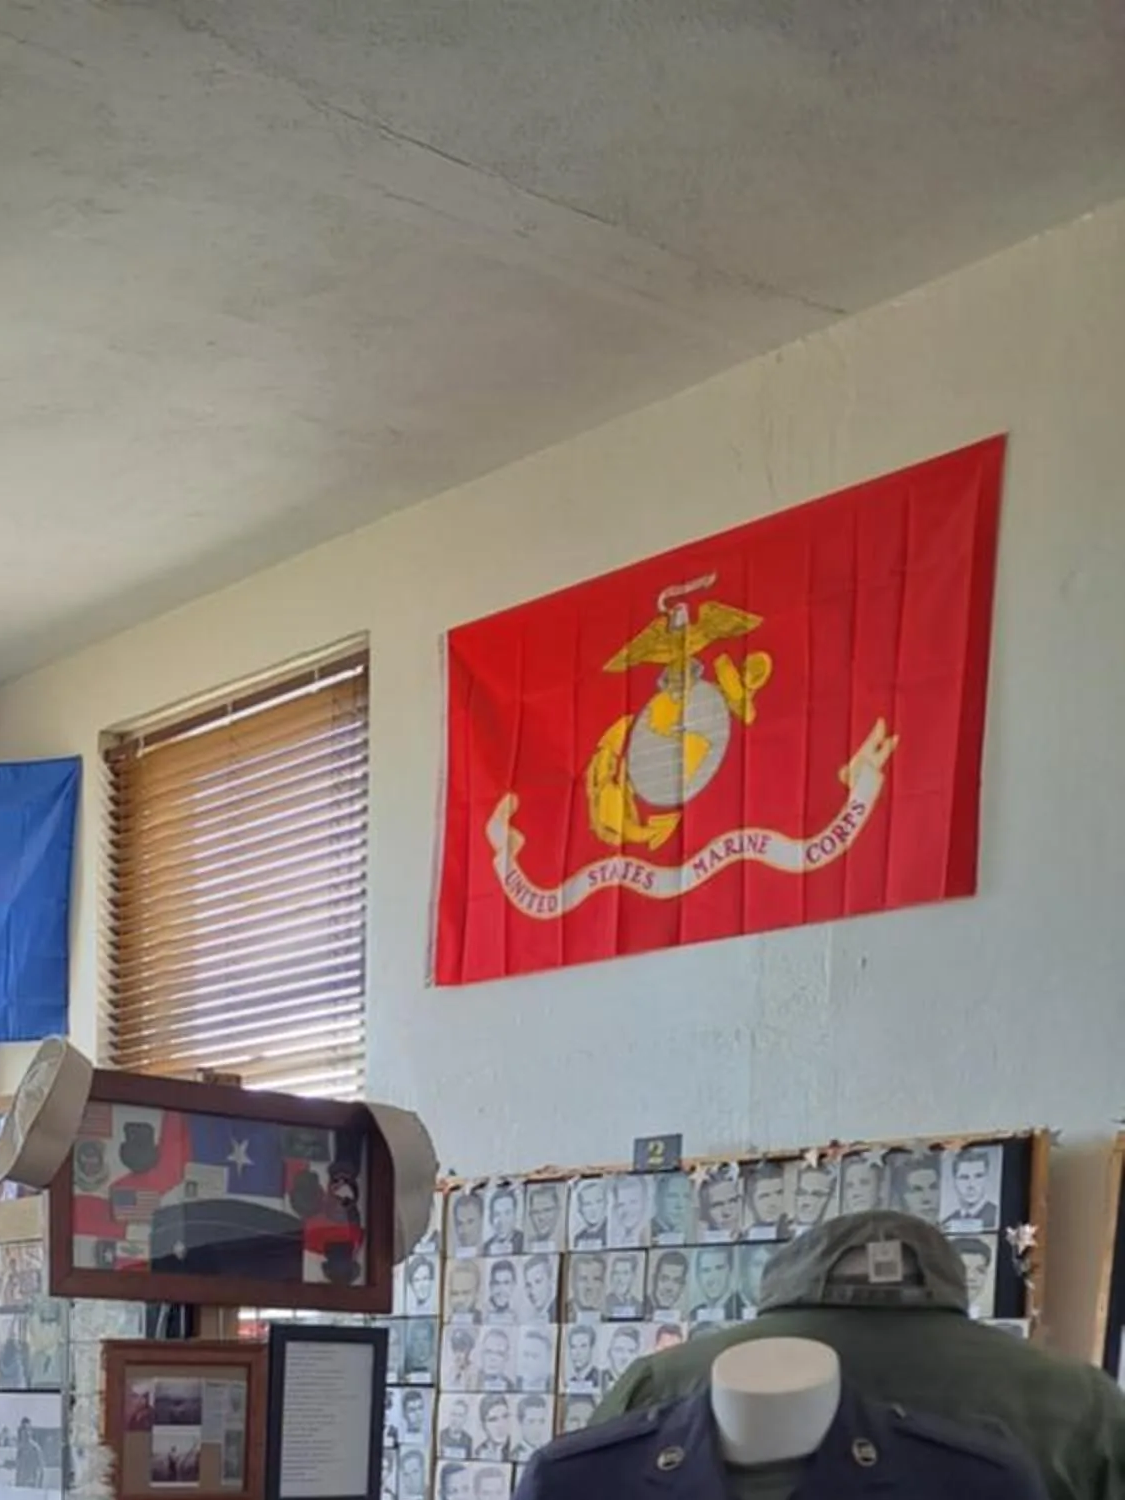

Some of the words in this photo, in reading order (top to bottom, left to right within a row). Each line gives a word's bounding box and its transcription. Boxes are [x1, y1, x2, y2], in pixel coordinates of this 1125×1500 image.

[504, 868, 559, 913] UNITED
[587, 860, 655, 890] STATES
[692, 833, 772, 878] MARINE
[805, 800, 867, 864] CORPS
[648, 1140, 664, 1164] 2
